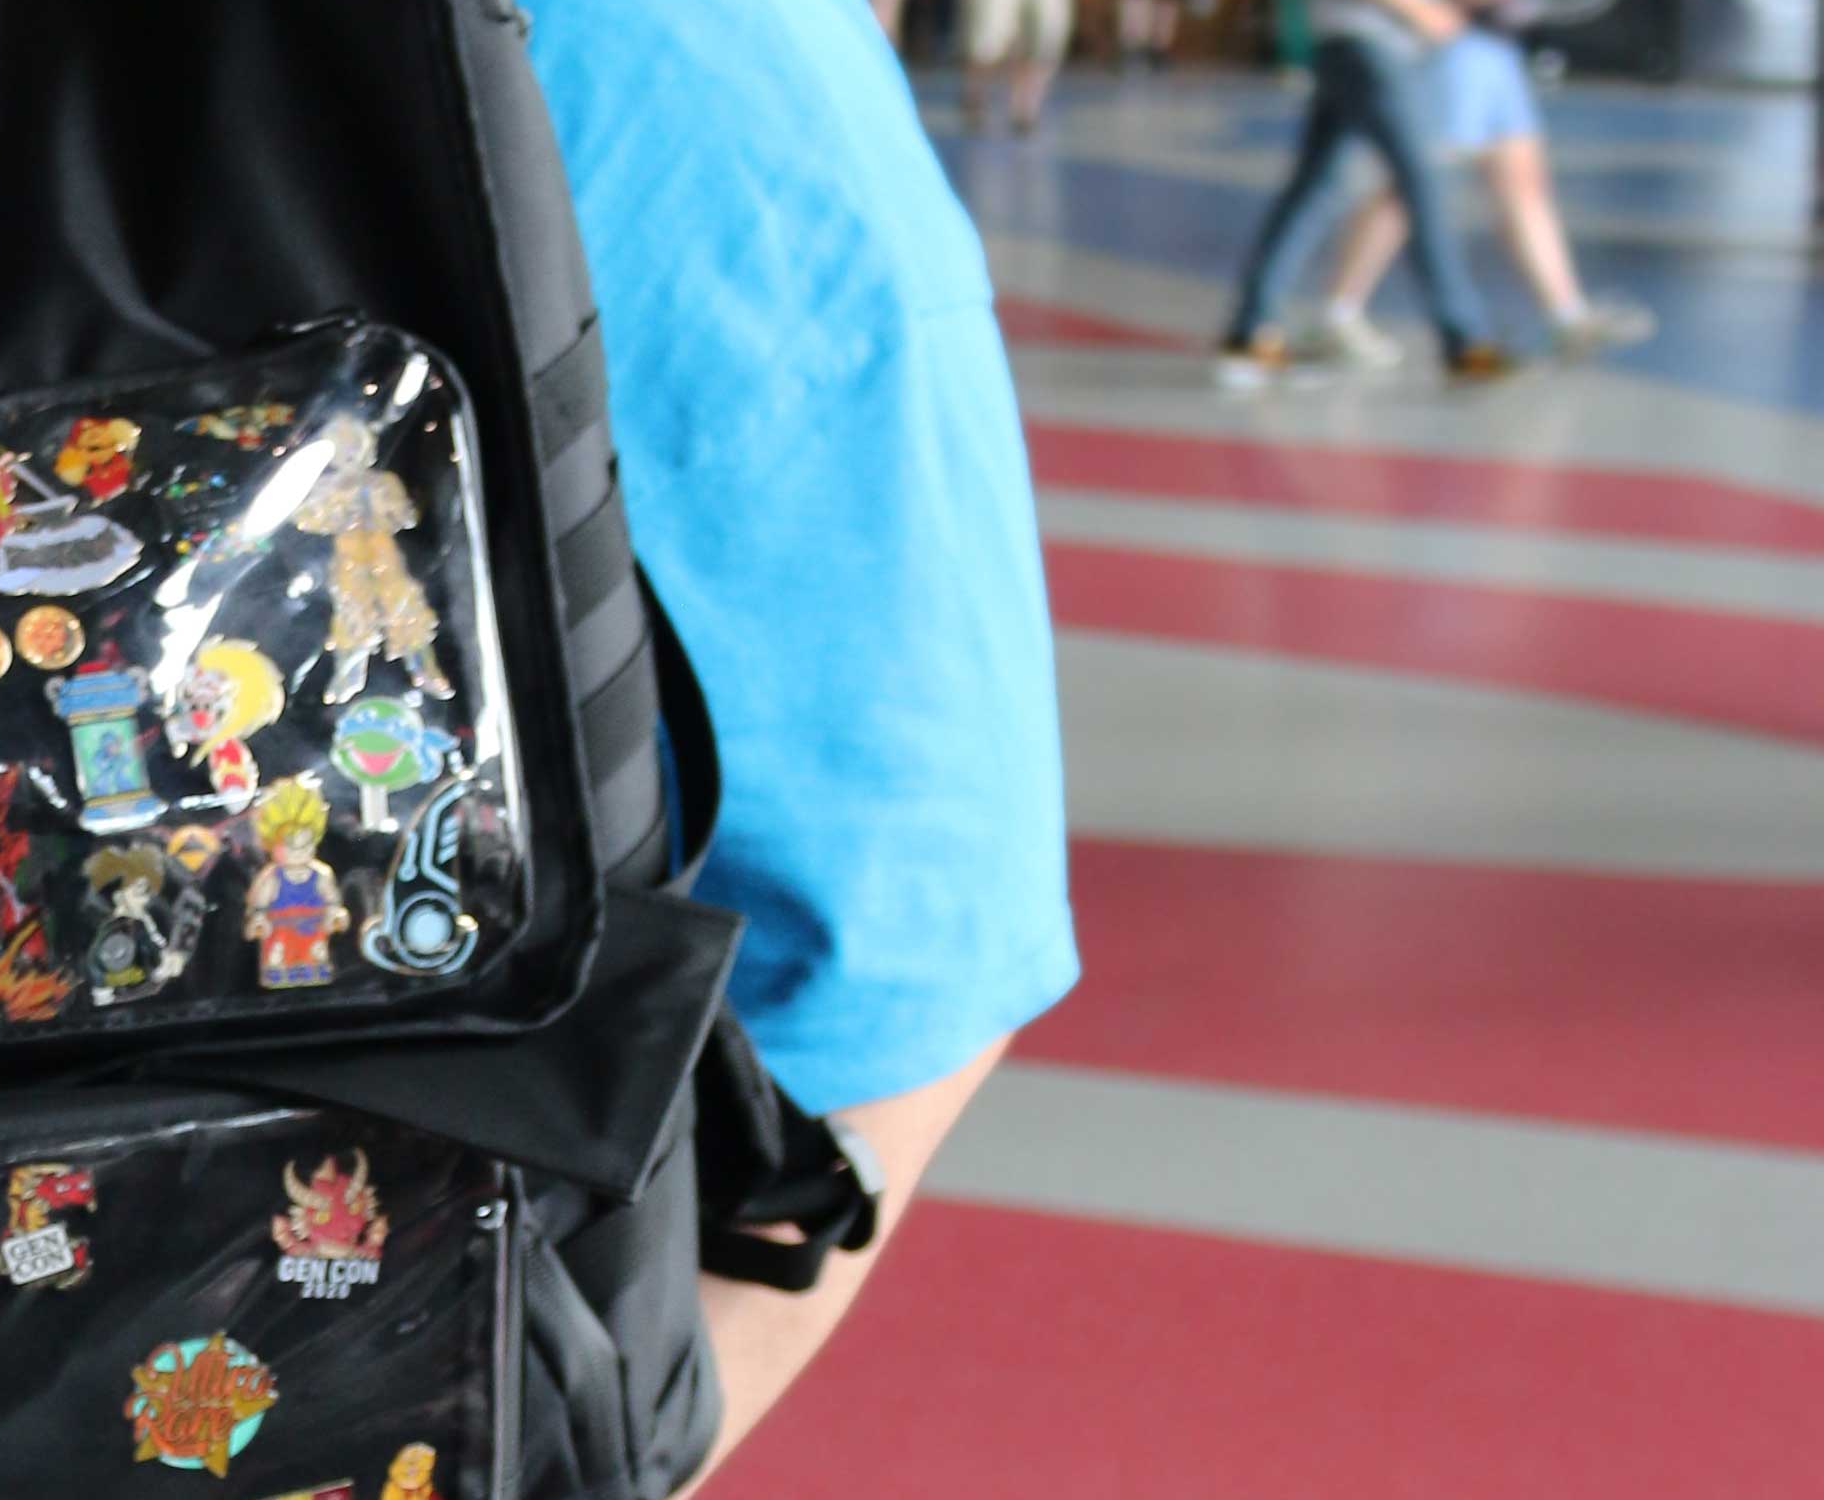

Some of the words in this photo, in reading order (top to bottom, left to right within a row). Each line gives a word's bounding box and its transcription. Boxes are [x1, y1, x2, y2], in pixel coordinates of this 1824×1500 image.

[10, 1231, 63, 1260] GEN
[16, 1250, 66, 1278] CON
[278, 1257, 328, 1282] GEN
[329, 1259, 380, 1285] CON
